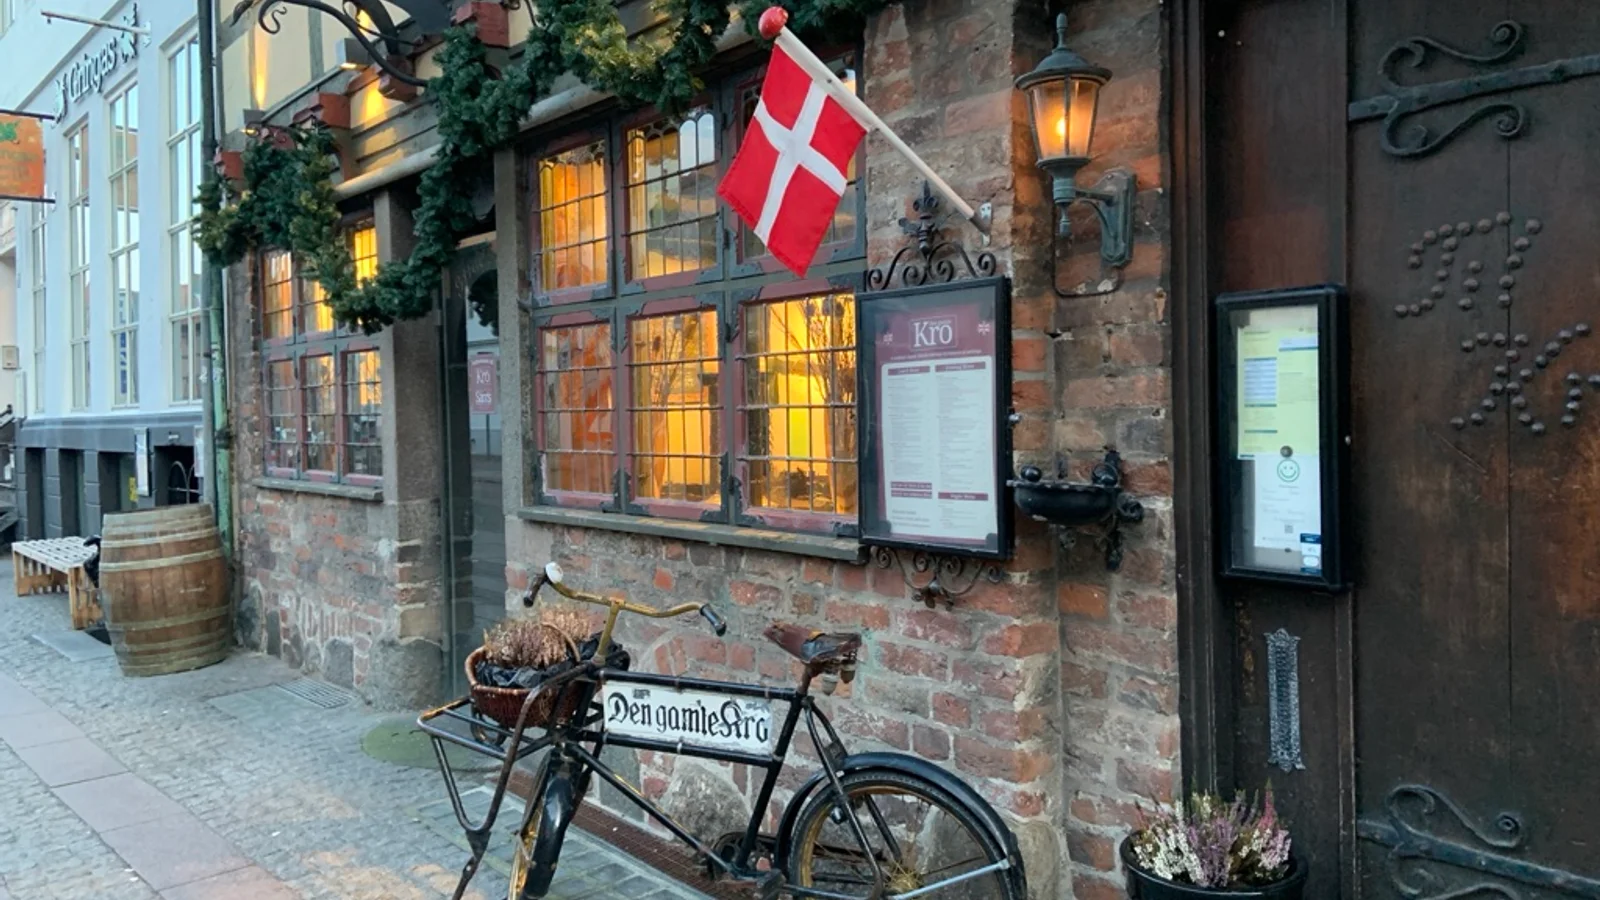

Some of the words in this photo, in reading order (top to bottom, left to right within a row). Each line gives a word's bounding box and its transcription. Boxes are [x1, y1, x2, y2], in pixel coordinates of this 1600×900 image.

[913, 321, 953, 347] Kro
[607, 691, 652, 726] Den
[656, 704, 720, 737] gamle
